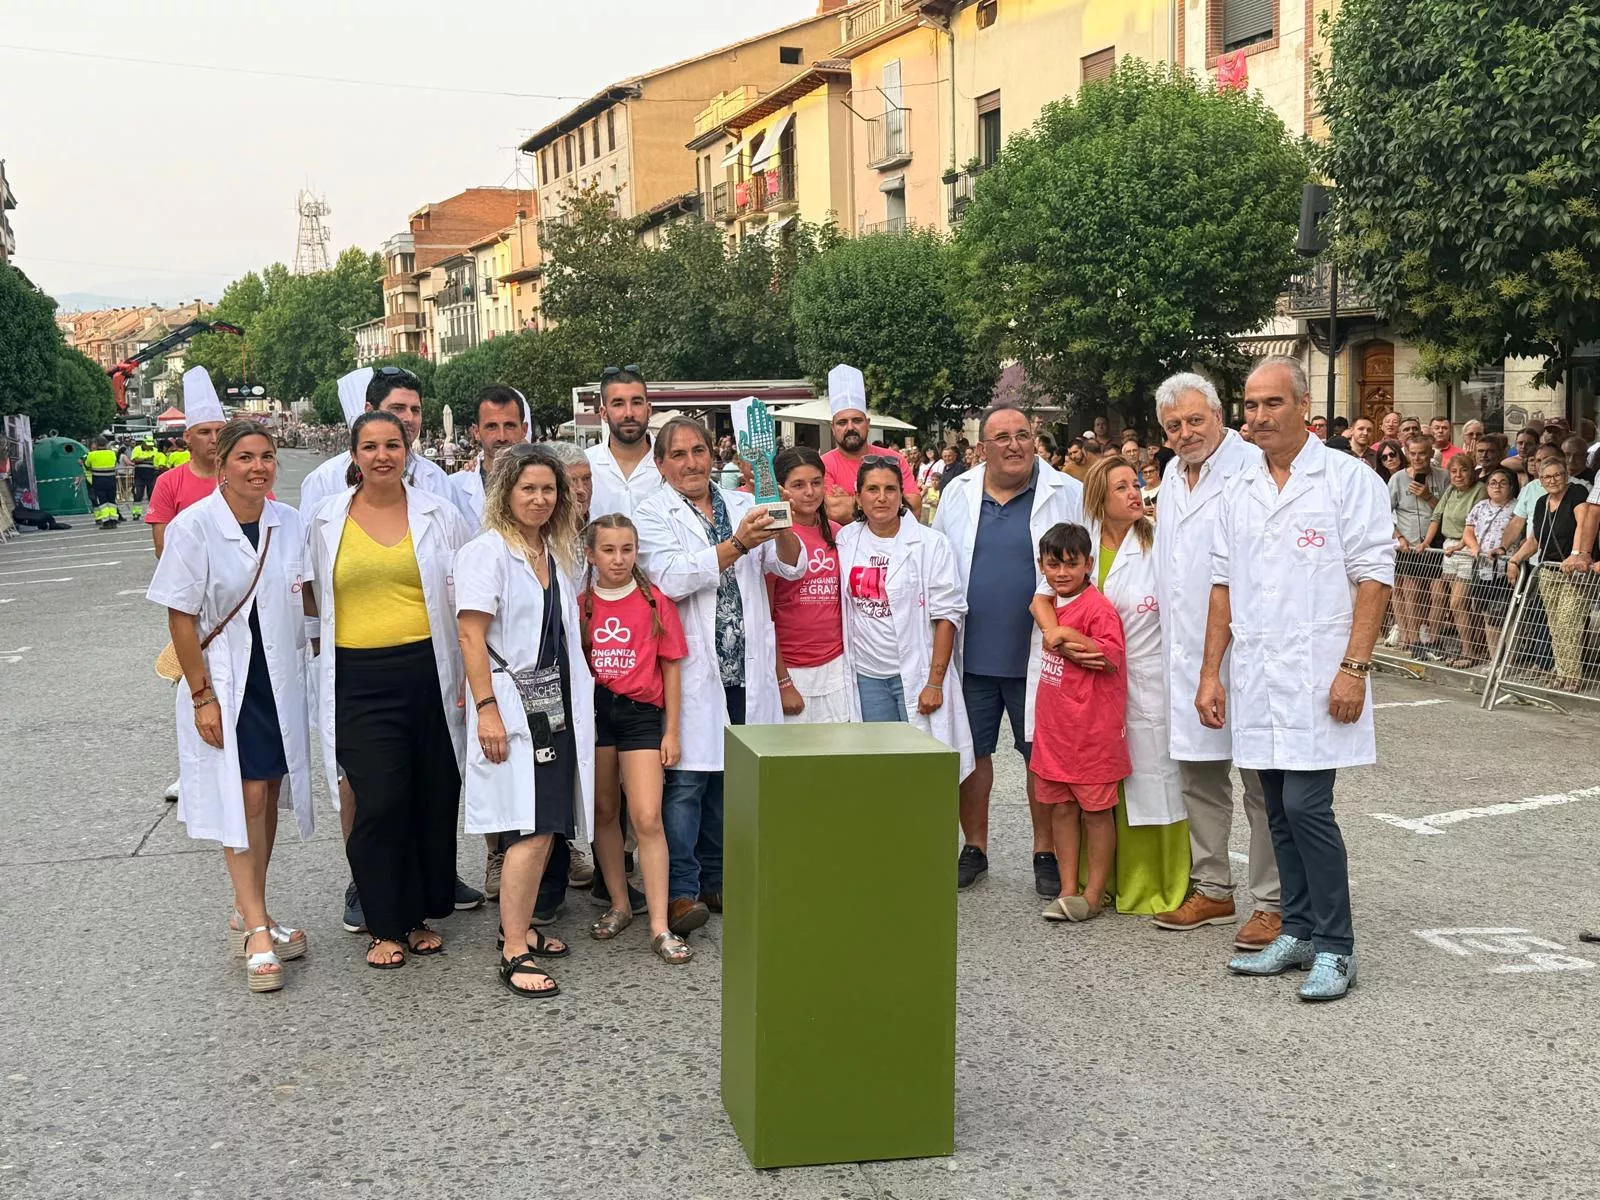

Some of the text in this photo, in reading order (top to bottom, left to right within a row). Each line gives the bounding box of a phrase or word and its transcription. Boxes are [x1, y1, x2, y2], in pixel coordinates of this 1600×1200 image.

[591, 649, 636, 657] ONGANIZA
[595, 657, 636, 669] GRAUS
[1041, 660, 1063, 676] RAUS
